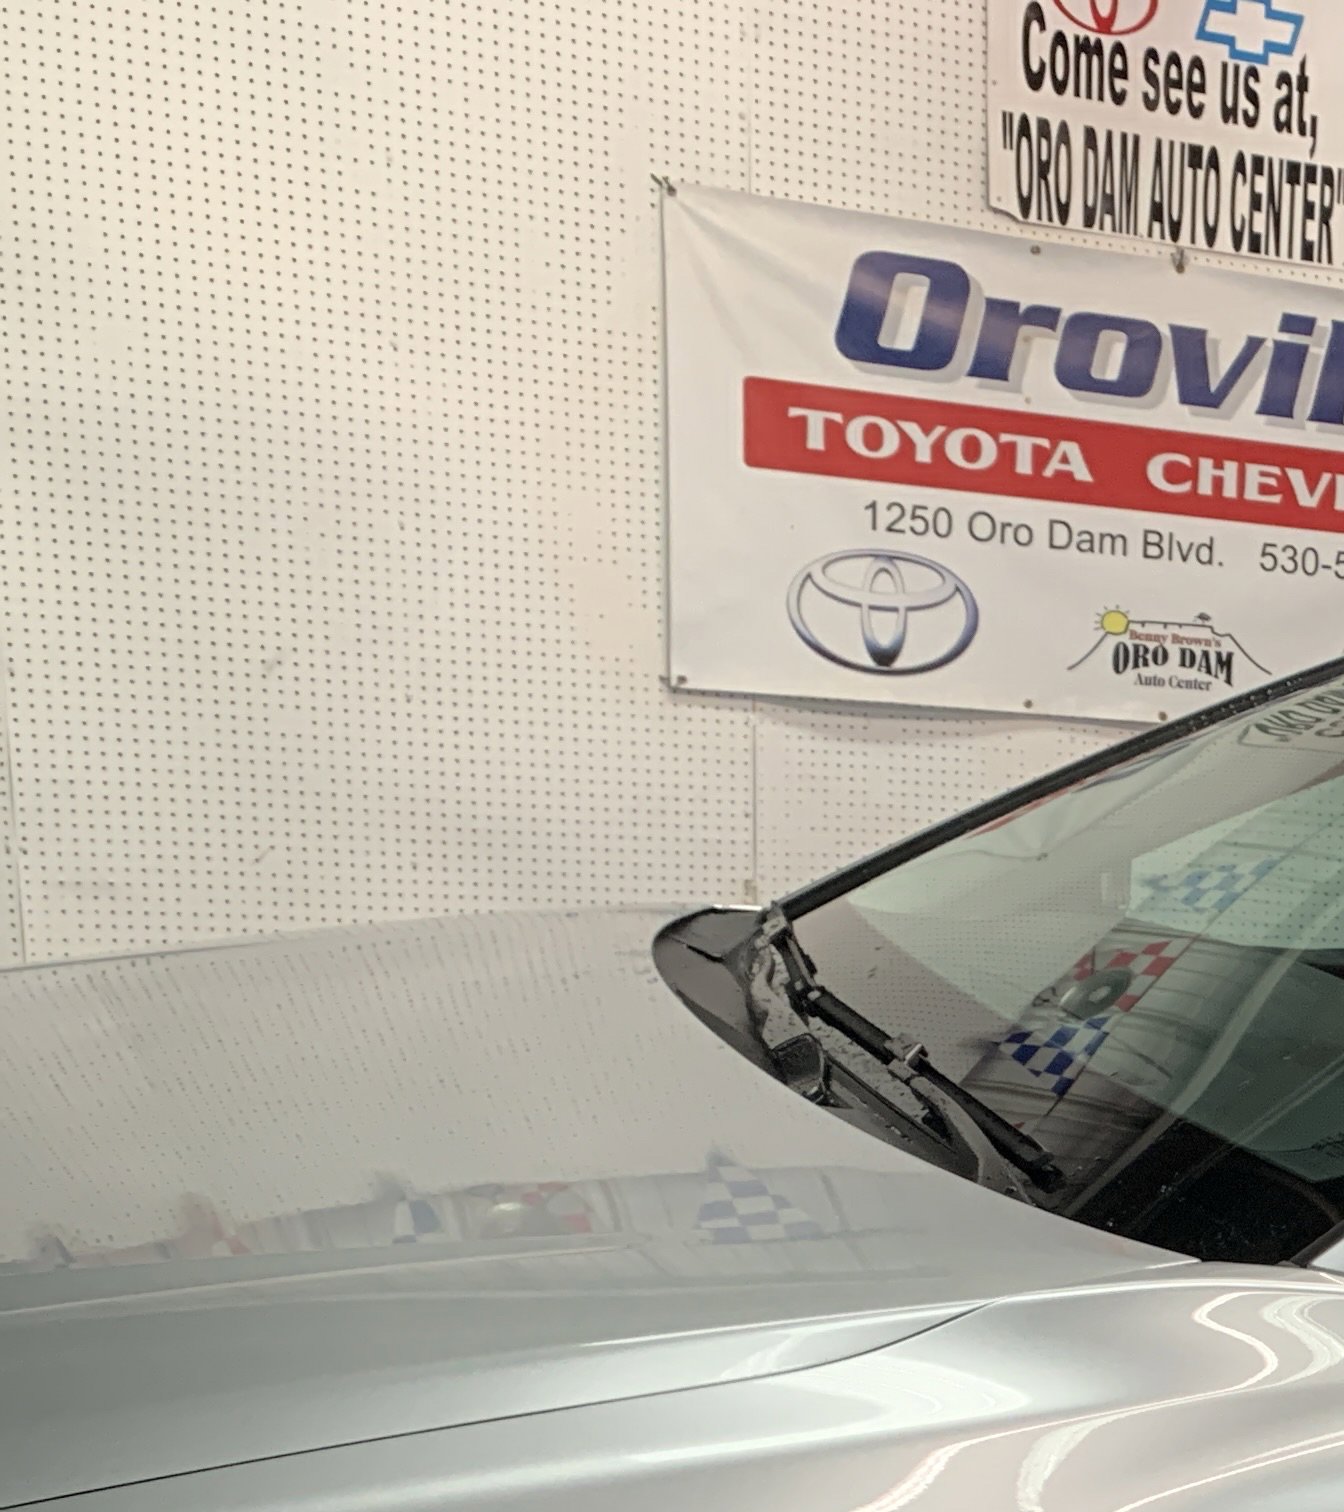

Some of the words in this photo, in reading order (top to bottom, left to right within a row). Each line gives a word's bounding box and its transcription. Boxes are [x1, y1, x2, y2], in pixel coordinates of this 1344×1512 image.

[1022, 1, 1129, 106] Come
[1141, 46, 1206, 119] see
[1220, 60, 1260, 128] us
[1273, 54, 1318, 158] at,
[1002, 110, 1073, 226] "ORO
[1083, 125, 1141, 237] DAM
[1150, 137, 1221, 249] AUTO
[787, 407, 1094, 482] TOYOTA
[864, 500, 952, 538] 1250
[967, 510, 1034, 546] Oro
[1048, 519, 1128, 557] Dam
[1142, 528, 1224, 567] Blvd.
[1112, 641, 1169, 675] ORO
[1178, 647, 1235, 687] DAM
[1134, 673, 1165, 688] Auto
[1168, 675, 1213, 691] Center
